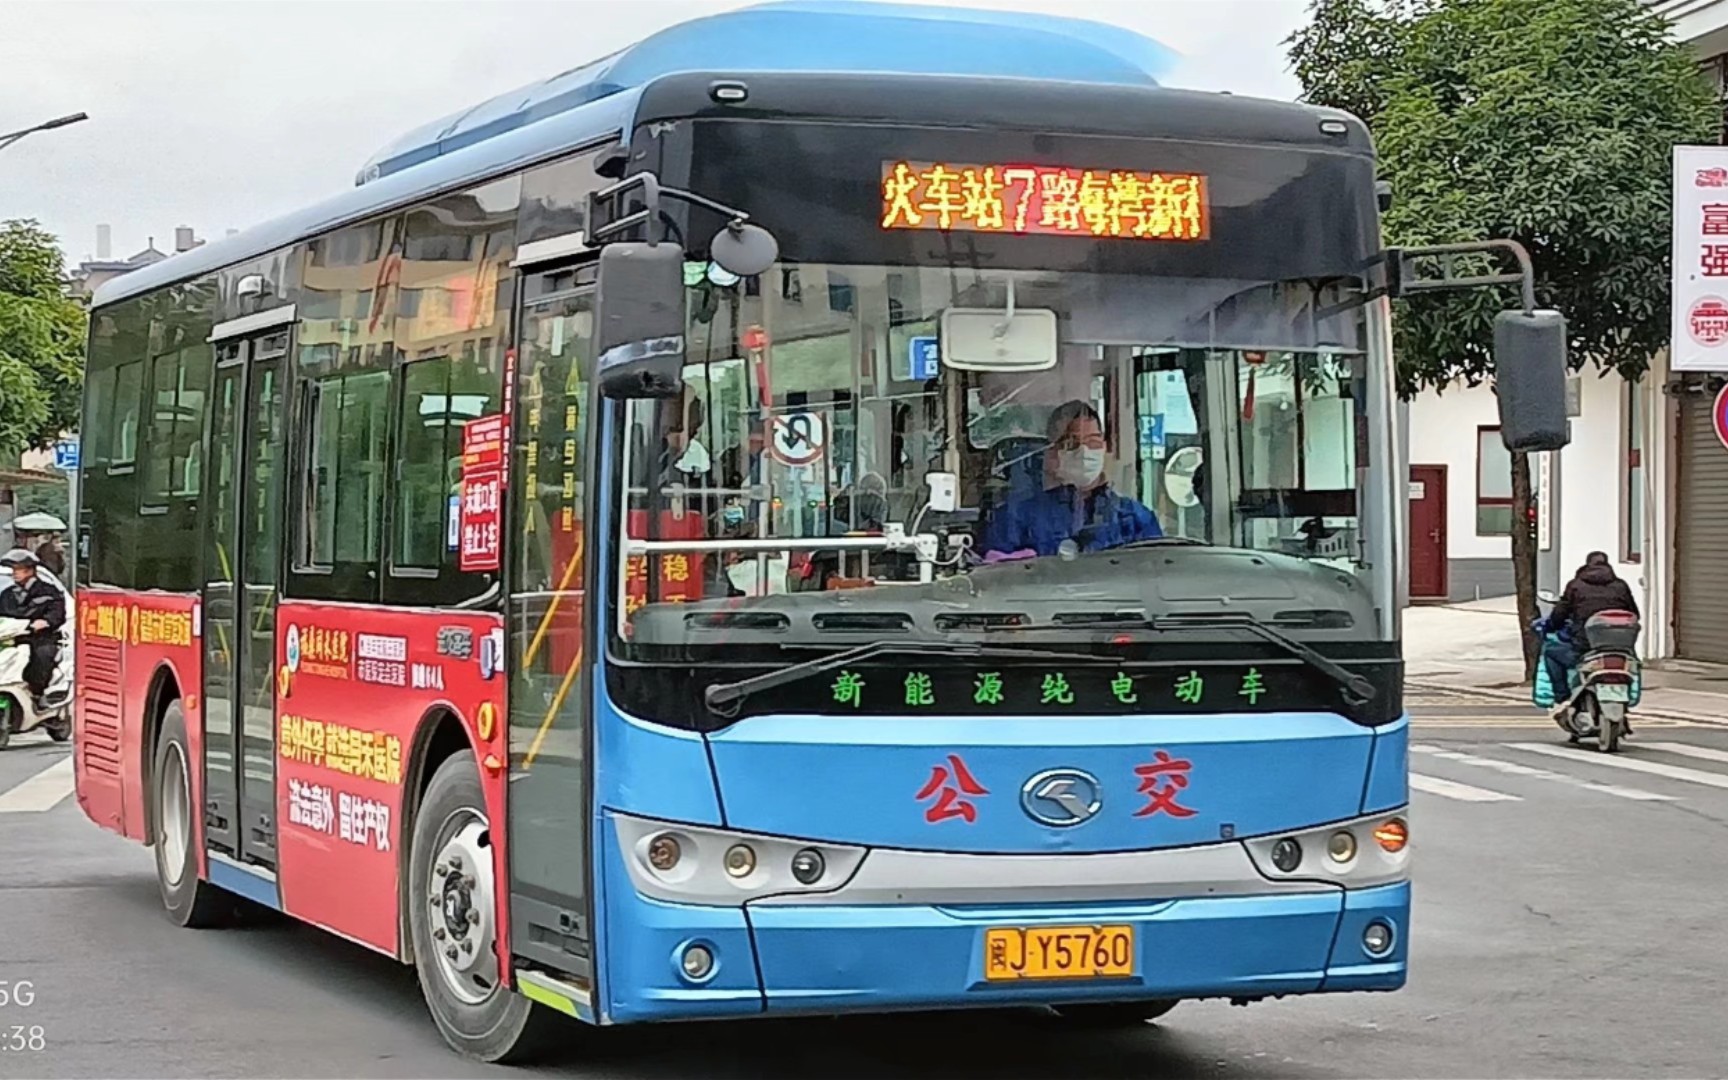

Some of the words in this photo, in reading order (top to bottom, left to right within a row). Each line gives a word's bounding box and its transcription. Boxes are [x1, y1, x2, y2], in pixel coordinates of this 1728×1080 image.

[1701, 203, 1728, 277] 富强
[831, 669, 1268, 708] 新能源纯电动车
